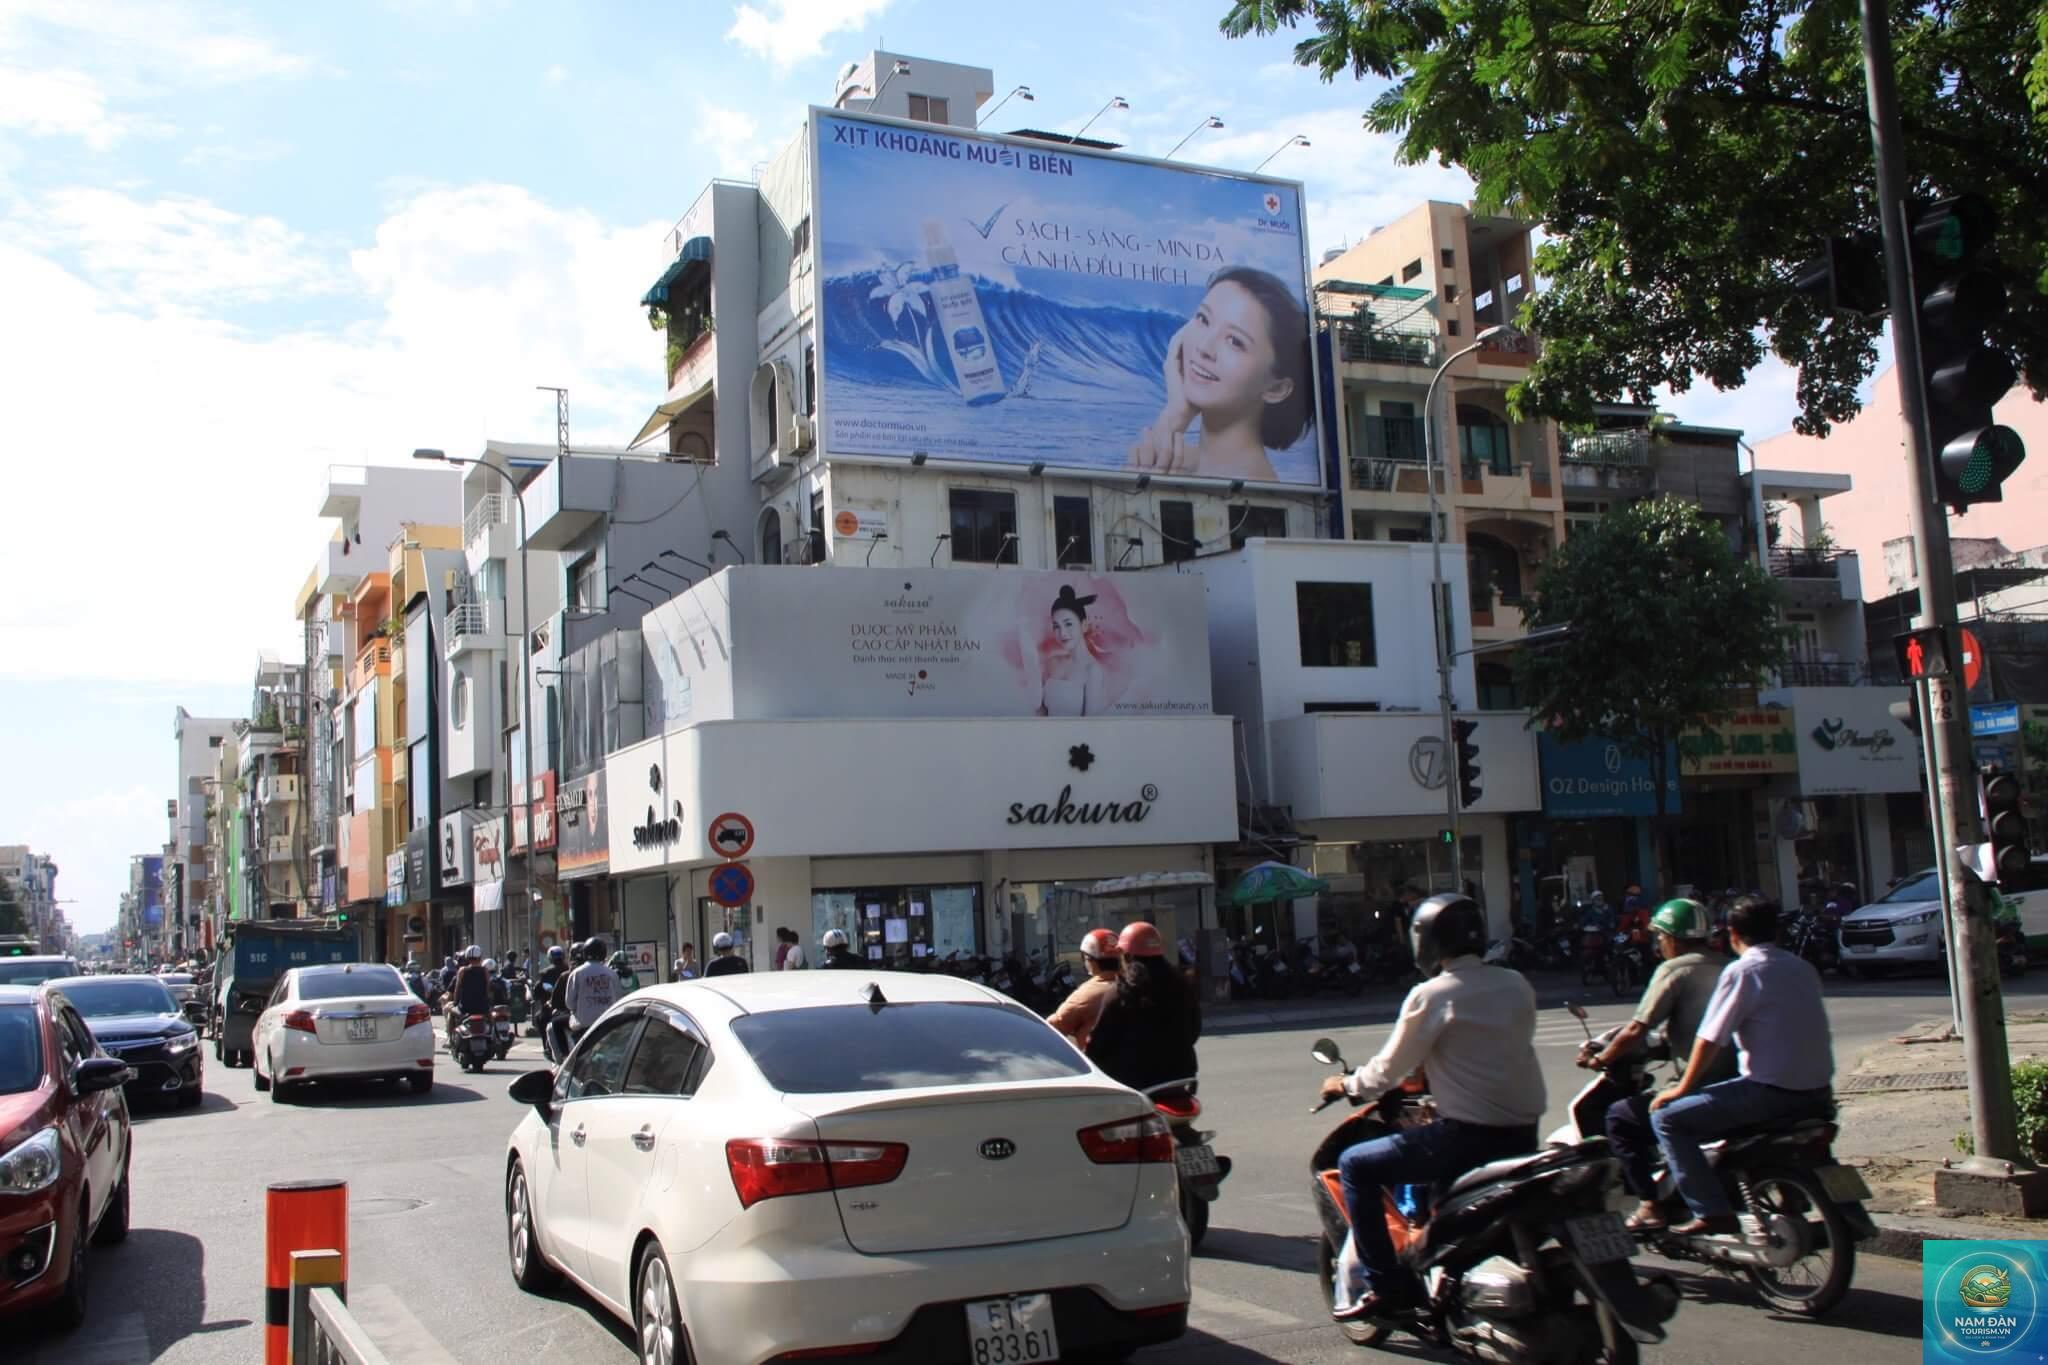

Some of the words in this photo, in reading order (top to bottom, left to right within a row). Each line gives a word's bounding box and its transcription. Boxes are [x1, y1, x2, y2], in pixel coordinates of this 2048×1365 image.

[834, 125, 869, 149] XỊT
[875, 131, 961, 159] KHOÁNG
[1015, 218, 1070, 242] SẠCH
[1087, 229, 1140, 251] SÁNG
[1197, 243, 1224, 263] DA
[1038, 250, 1082, 273] NHÀ
[1126, 262, 1187, 286] THÍCH
[851, 638, 882, 651] CAO
[1550, 777, 1574, 794] OZ
[1578, 777, 1628, 797] Design
[984, 1142, 1012, 1157] KIA
[975, 1329, 1052, 1365] 833.61
